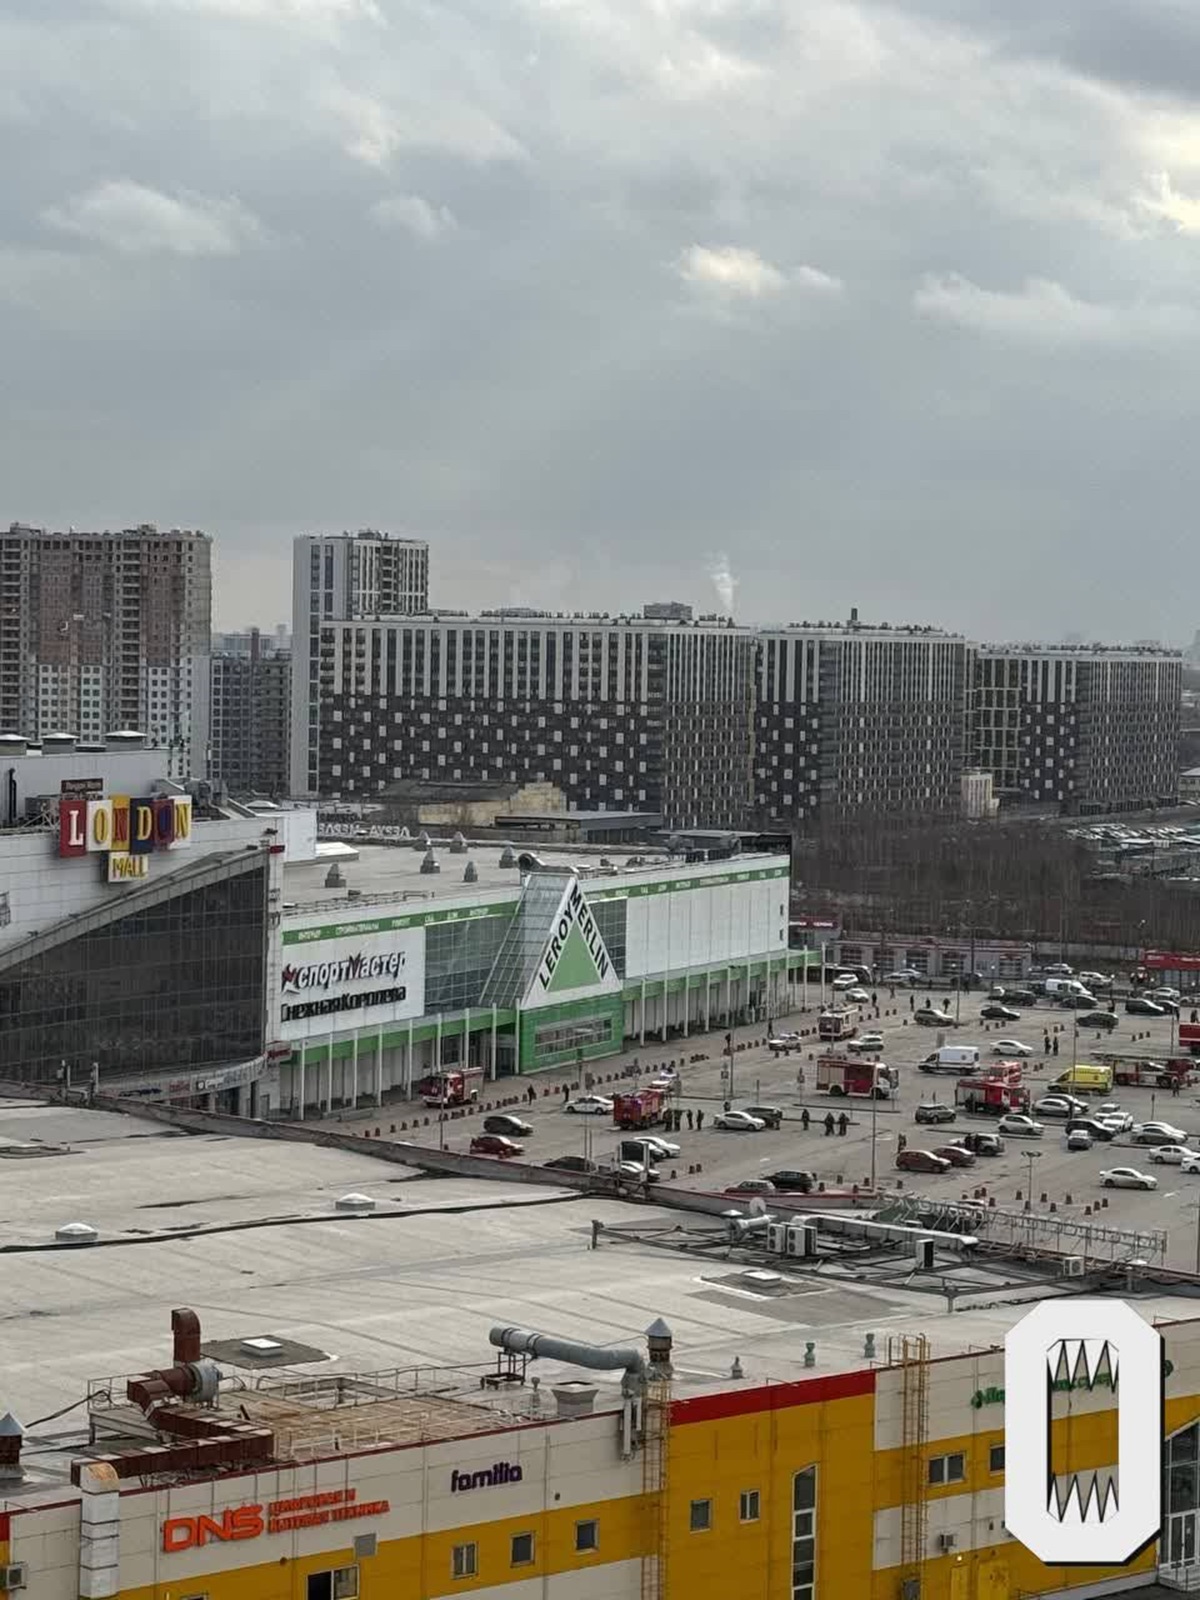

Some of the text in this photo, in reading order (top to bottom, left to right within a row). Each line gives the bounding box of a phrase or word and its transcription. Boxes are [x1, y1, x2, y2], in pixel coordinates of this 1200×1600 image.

[69, 803, 188, 846] LONDON
[112, 857, 145, 879] MALL
[539, 884, 609, 990] LEROY MERLIN
[451, 1463, 522, 1493] familia
[163, 1503, 264, 1552] DNS
